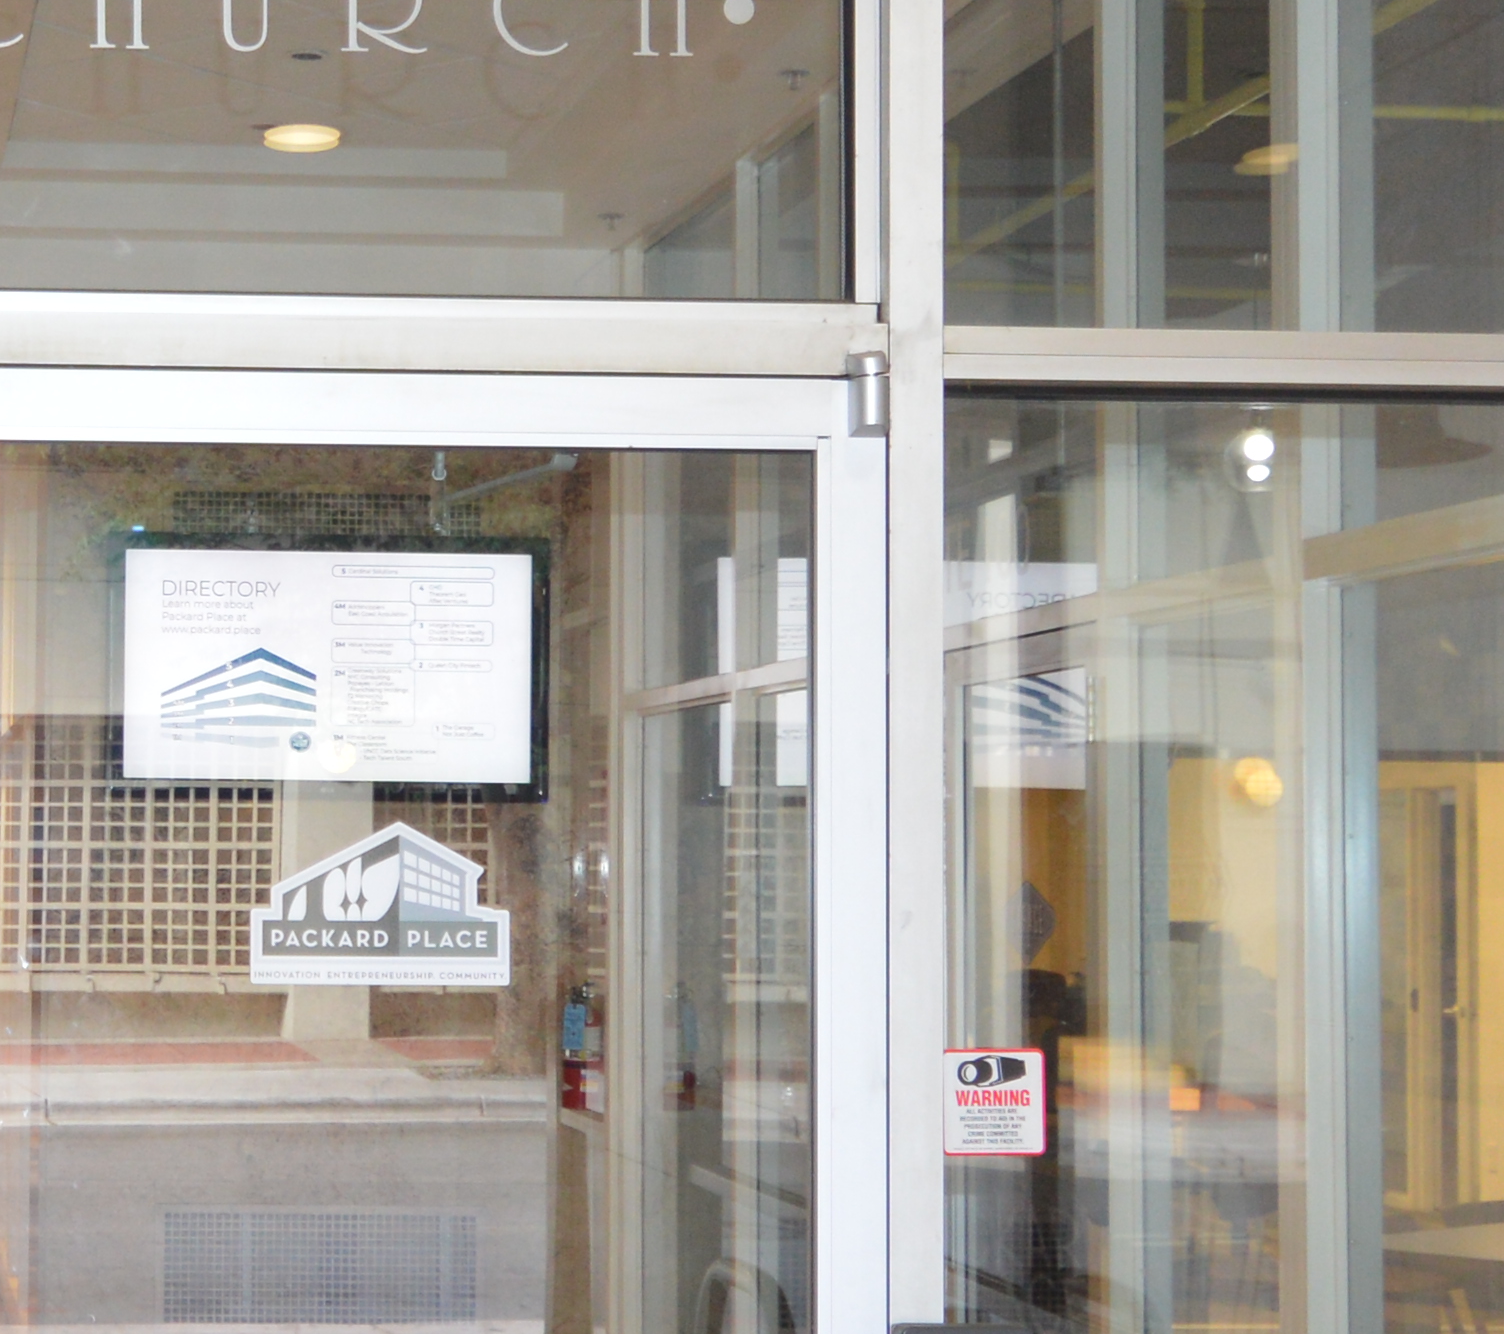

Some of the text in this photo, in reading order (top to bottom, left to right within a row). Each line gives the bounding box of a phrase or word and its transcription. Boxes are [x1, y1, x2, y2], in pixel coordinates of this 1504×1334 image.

[162, 579, 282, 598] DIRECTORY
[162, 599, 191, 609] Learn
[223, 600, 254, 610] about
[162, 612, 204, 622] Packard
[206, 612, 234, 622] Place
[270, 929, 488, 949] PACKARD PLACE
[955, 1088, 1032, 1107] WARNING
